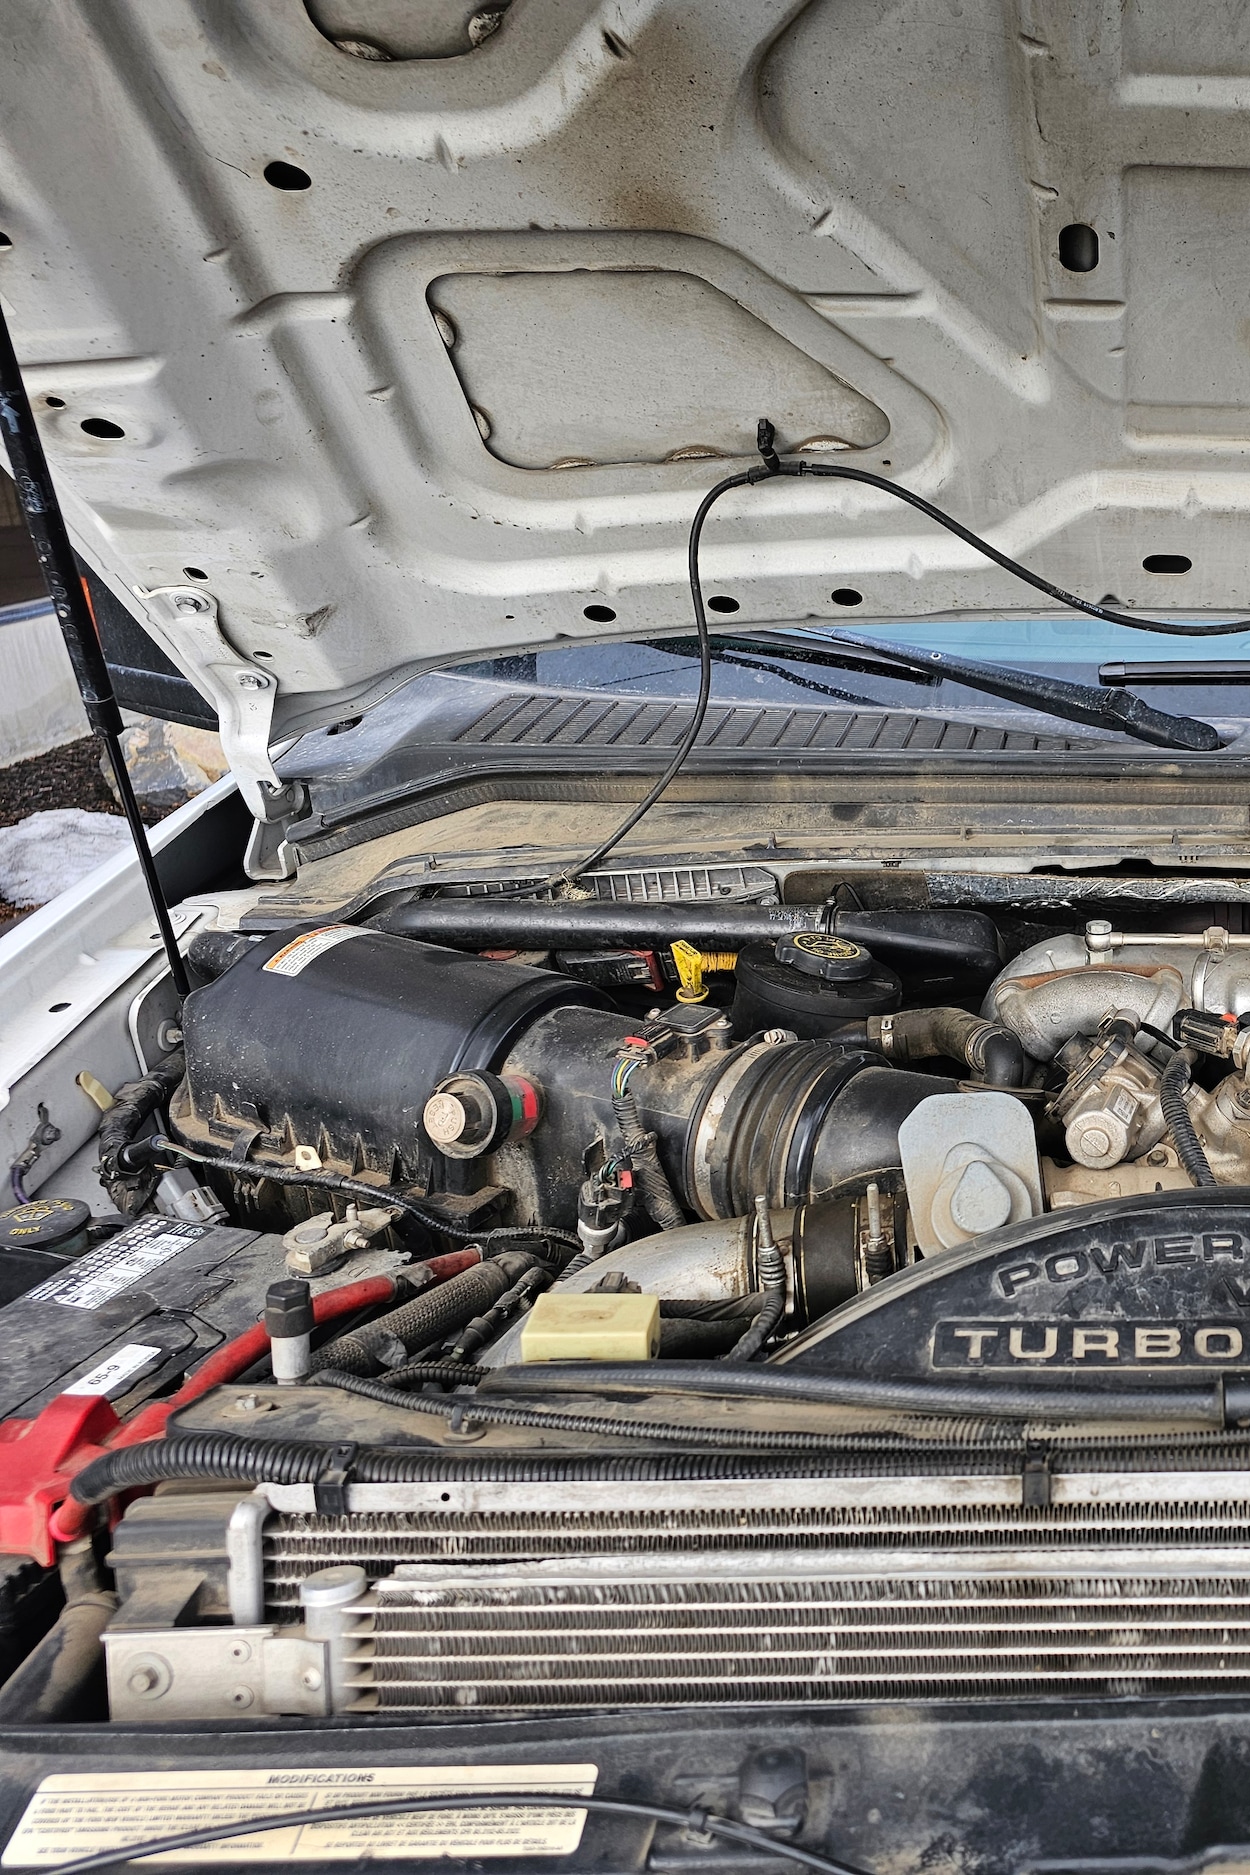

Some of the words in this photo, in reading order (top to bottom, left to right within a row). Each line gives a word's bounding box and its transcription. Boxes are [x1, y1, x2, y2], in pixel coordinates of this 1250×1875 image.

[9, 1226, 41, 1236] ONLY
[997, 1232, 1245, 1300] POWER
[954, 1326, 1245, 1361] TURBO
[87, 1364, 120, 1385] 65-9
[267, 1773, 376, 1785] MODIFICATIONS
